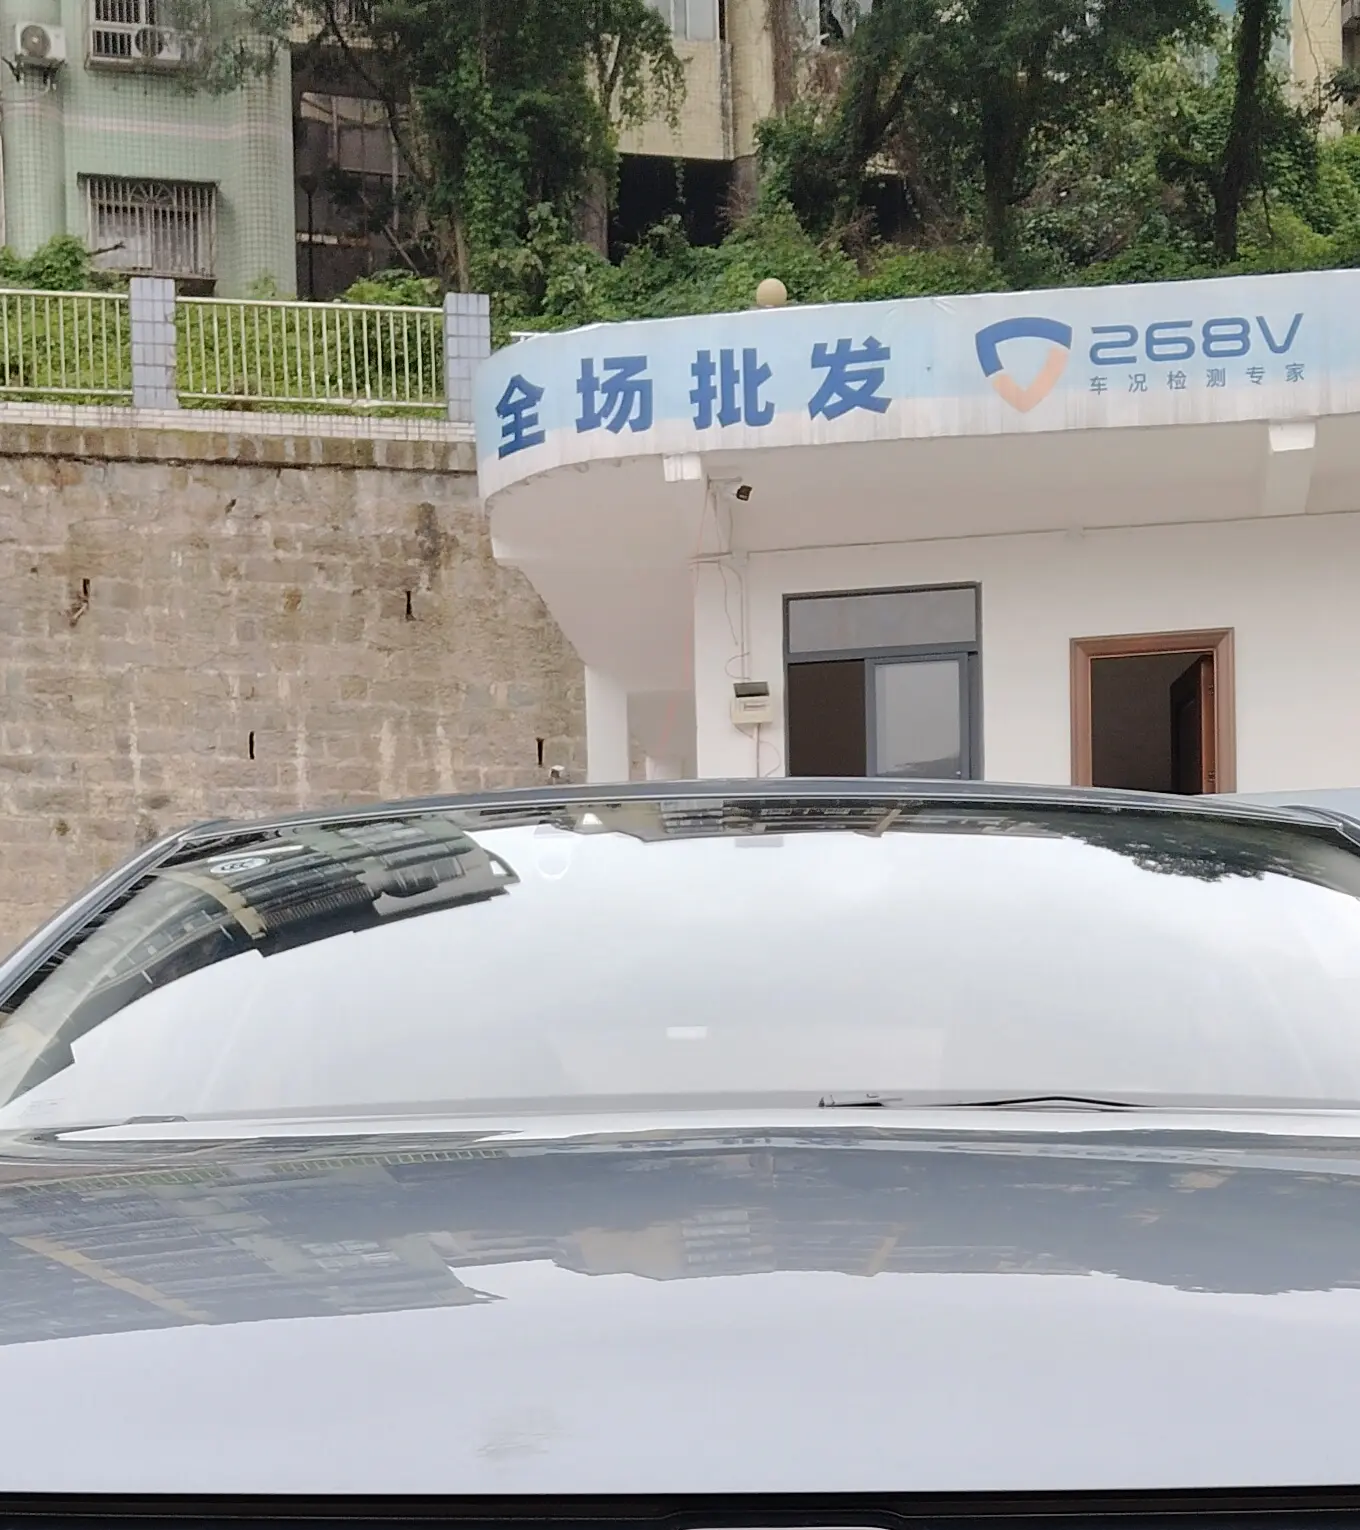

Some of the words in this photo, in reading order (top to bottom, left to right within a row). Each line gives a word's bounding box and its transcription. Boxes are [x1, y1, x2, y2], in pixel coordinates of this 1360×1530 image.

[1088, 312, 1305, 366] 268V
[496, 335, 894, 459] 全场批发
[1088, 362, 1306, 396] 车况检测专家
